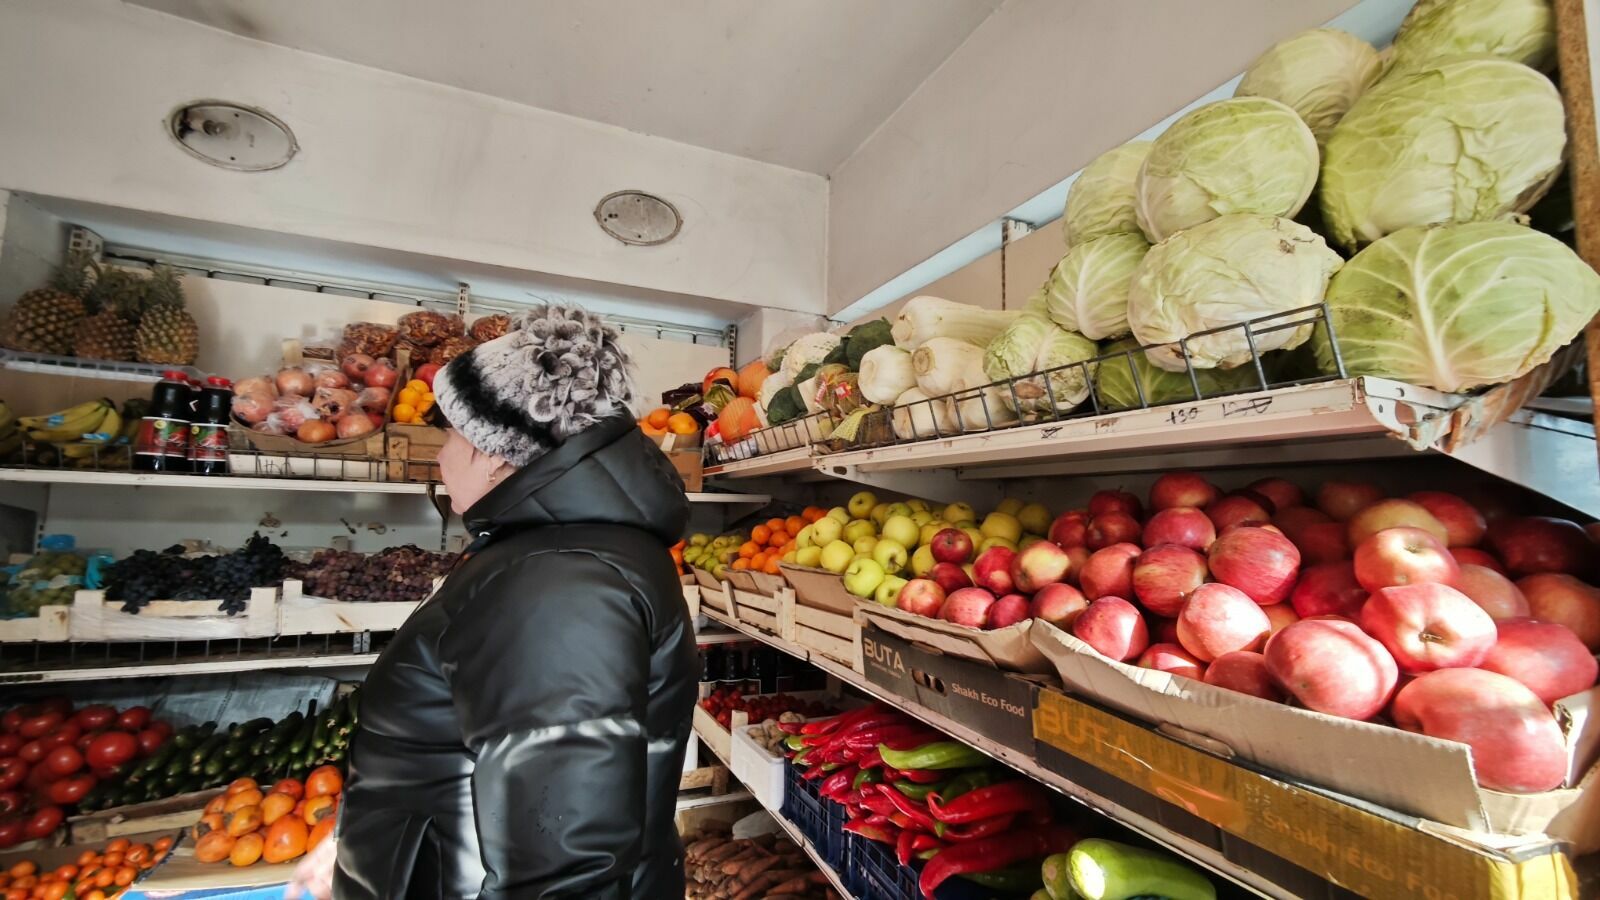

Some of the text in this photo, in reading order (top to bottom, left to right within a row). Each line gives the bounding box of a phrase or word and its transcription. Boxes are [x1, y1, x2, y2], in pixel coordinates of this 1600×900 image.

[864, 638, 906, 673] BUTA
[951, 682, 1026, 717] Shakh Eco Food
[1040, 703, 1143, 772] BUTA
[1347, 847, 1395, 881] Eco
